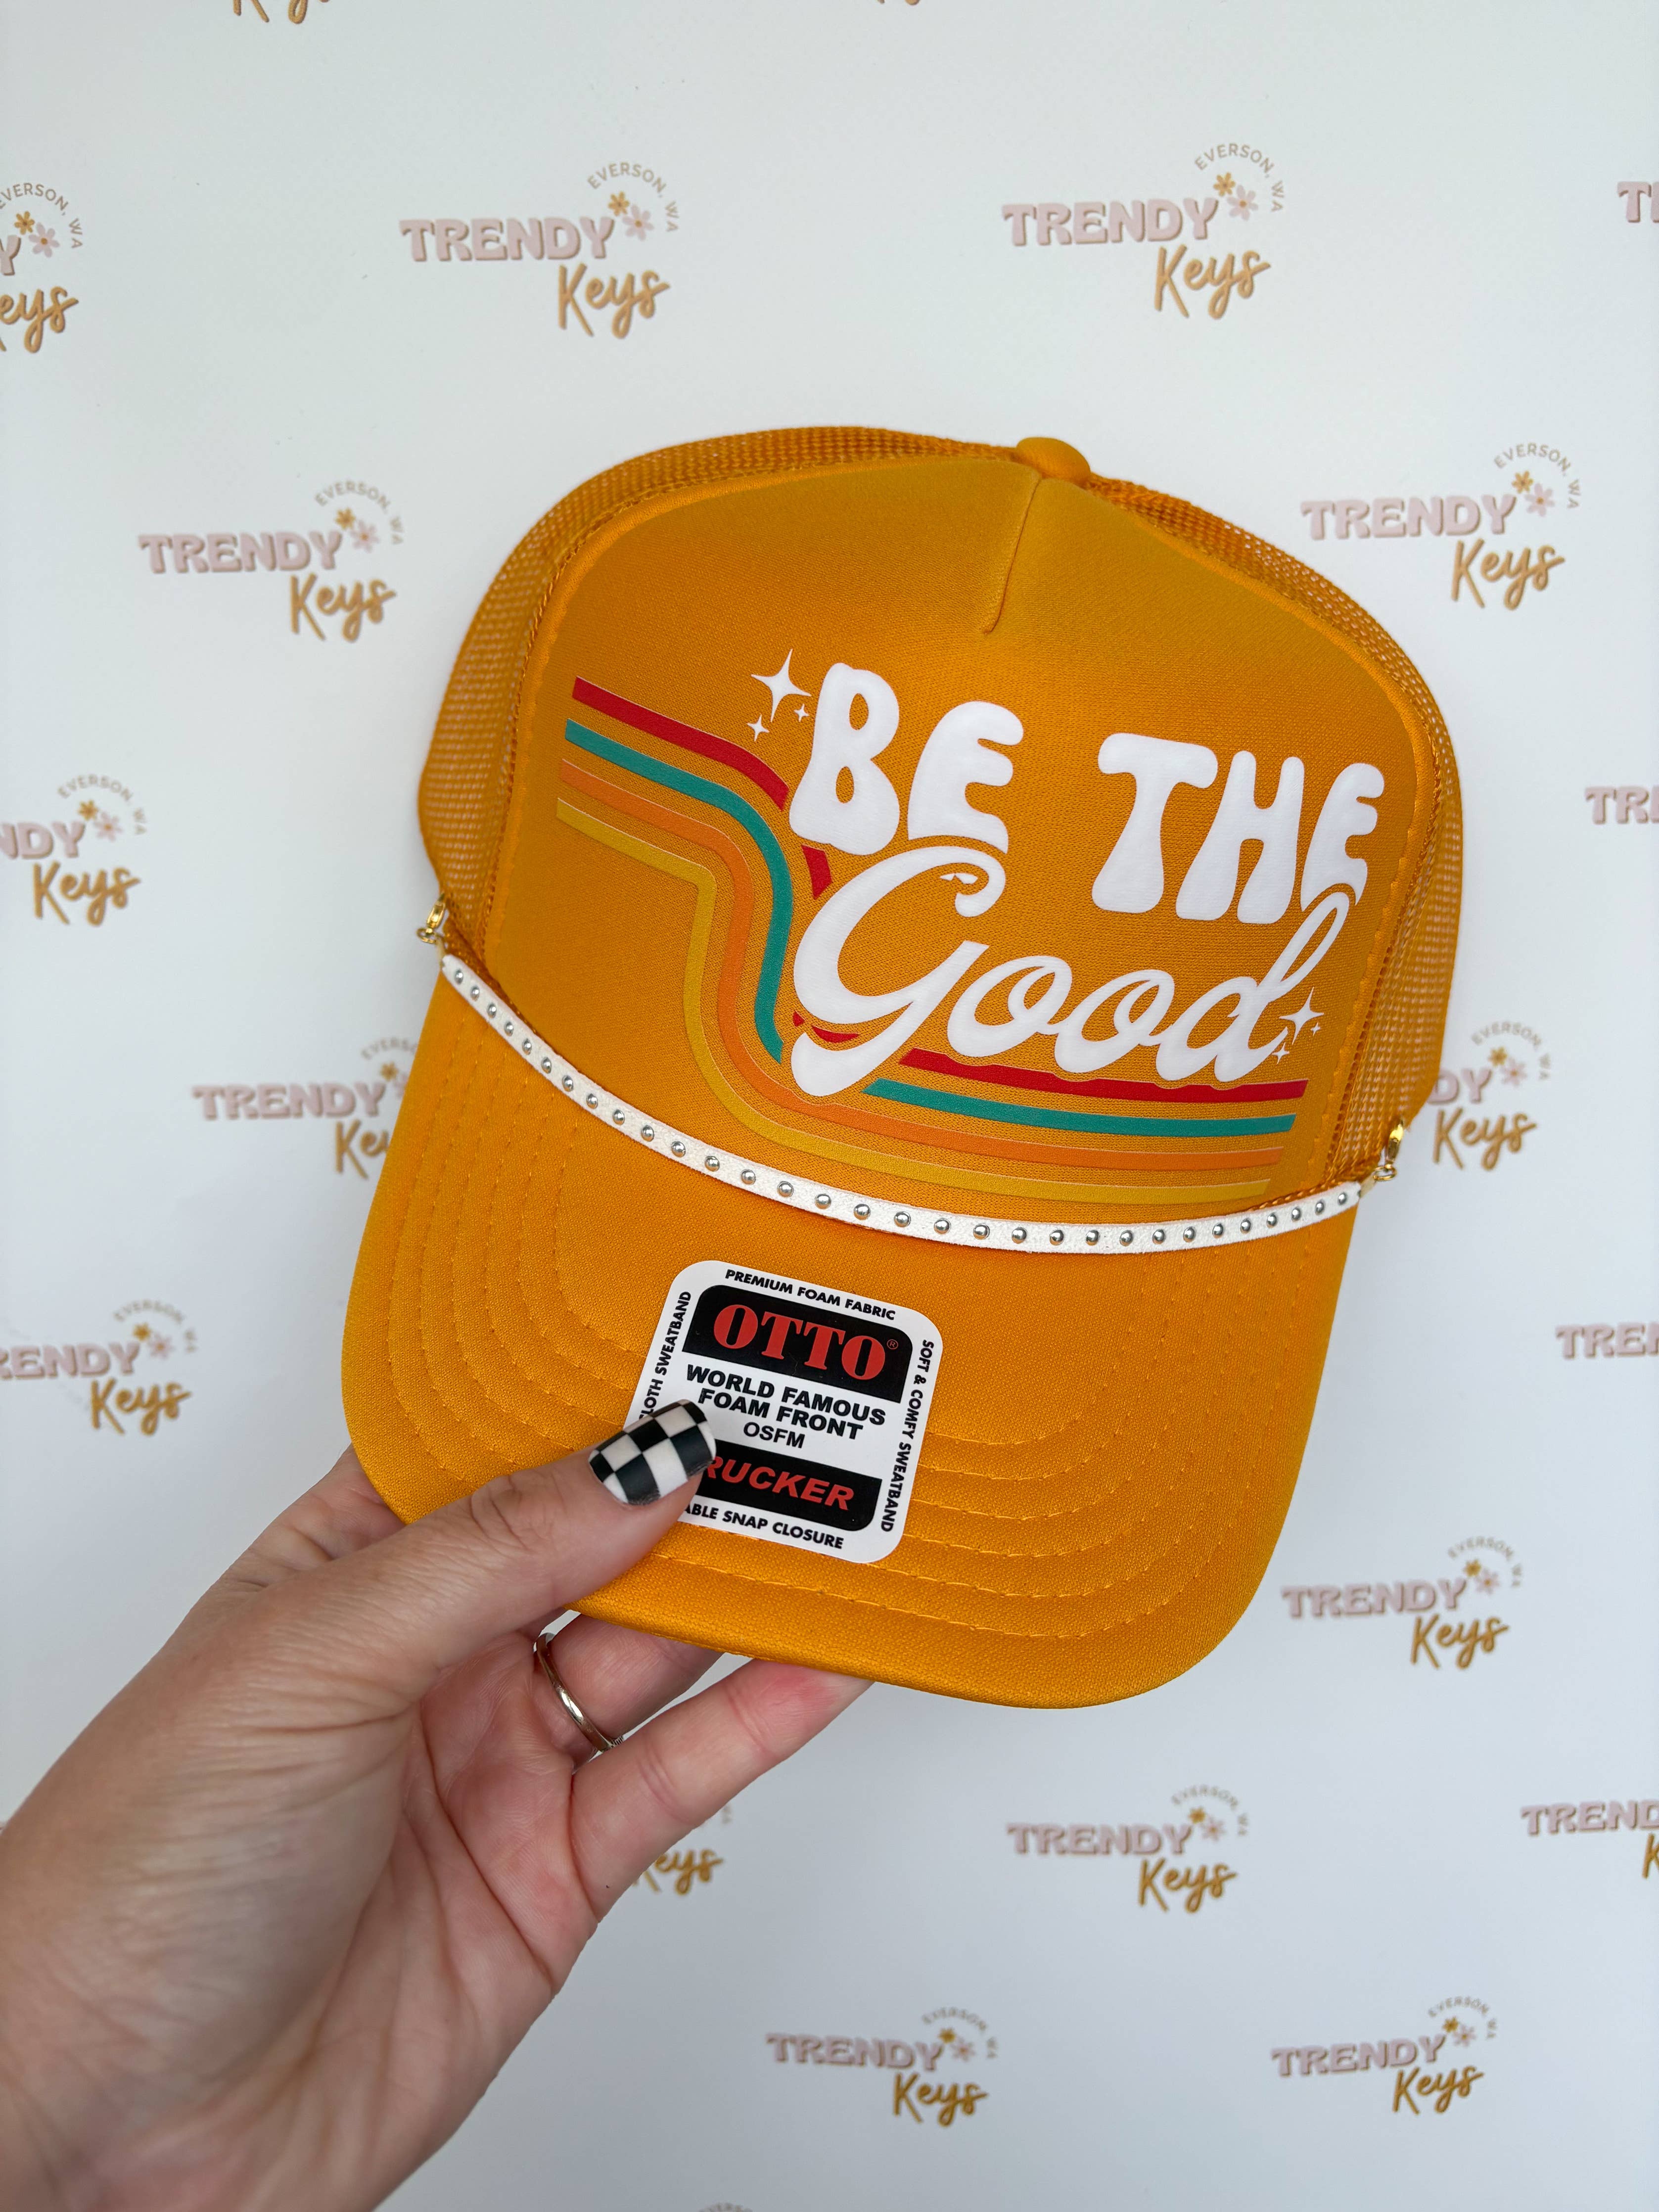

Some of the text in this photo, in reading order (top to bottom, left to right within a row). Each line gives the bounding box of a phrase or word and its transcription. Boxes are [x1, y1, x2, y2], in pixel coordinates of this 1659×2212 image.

[587, 162, 679, 232] EVERSON, WA
[1195, 143, 1285, 213] EVERSON, WA
[69, 218, 83, 248] WA
[399, 217, 614, 262] TRENDY
[1002, 197, 1219, 246] TRENDY
[558, 263, 670, 339] Keys
[1154, 244, 1271, 320] Keys
[0, 286, 79, 353] eys
[1300, 494, 1516, 540] TRENDY
[1566, 478, 1581, 509] WA
[138, 530, 342, 574] TRENDY
[1451, 538, 1565, 610] Keys
[290, 573, 396, 643] Keys
[789, 662, 1385, 924] BE THE
[33, 860, 141, 927] Keys
[791, 845, 1349, 1096] Good
[192, 1082, 386, 1120] TRENDY
[1432, 1106, 1536, 1171] Keys
[725, 1269, 896, 1321] PREMIUM FOAM FABRIC
[654, 1291, 691, 1376] SWEATBAND
[90, 1377, 193, 1436] Keys
[687, 1364, 886, 1426] WORLD FAMOUS
[698, 1387, 864, 1440] FOAM FRONT
[743, 1422, 806, 1449] OSFM
[880, 1339, 934, 1532] SOFT & COMFY SWEATBAND
[704, 1456, 855, 1511] RUCKER
[722, 1510, 768, 1529] SNAP
[772, 1521, 844, 1550] CLOSURE
[1281, 1578, 1468, 1619] TRENDY
[1410, 1613, 1511, 1670] Keys
[1006, 1822, 1193, 1856] TRENDY
[632, 1848, 724, 1895] eys
[1138, 1857, 1238, 1914] Keys
[766, 2032, 944, 2072] TRENDY
[1271, 2033, 1447, 2078] TRENDY
[893, 2071, 989, 2128] Keys
[1392, 2066, 1485, 2116] Keys
